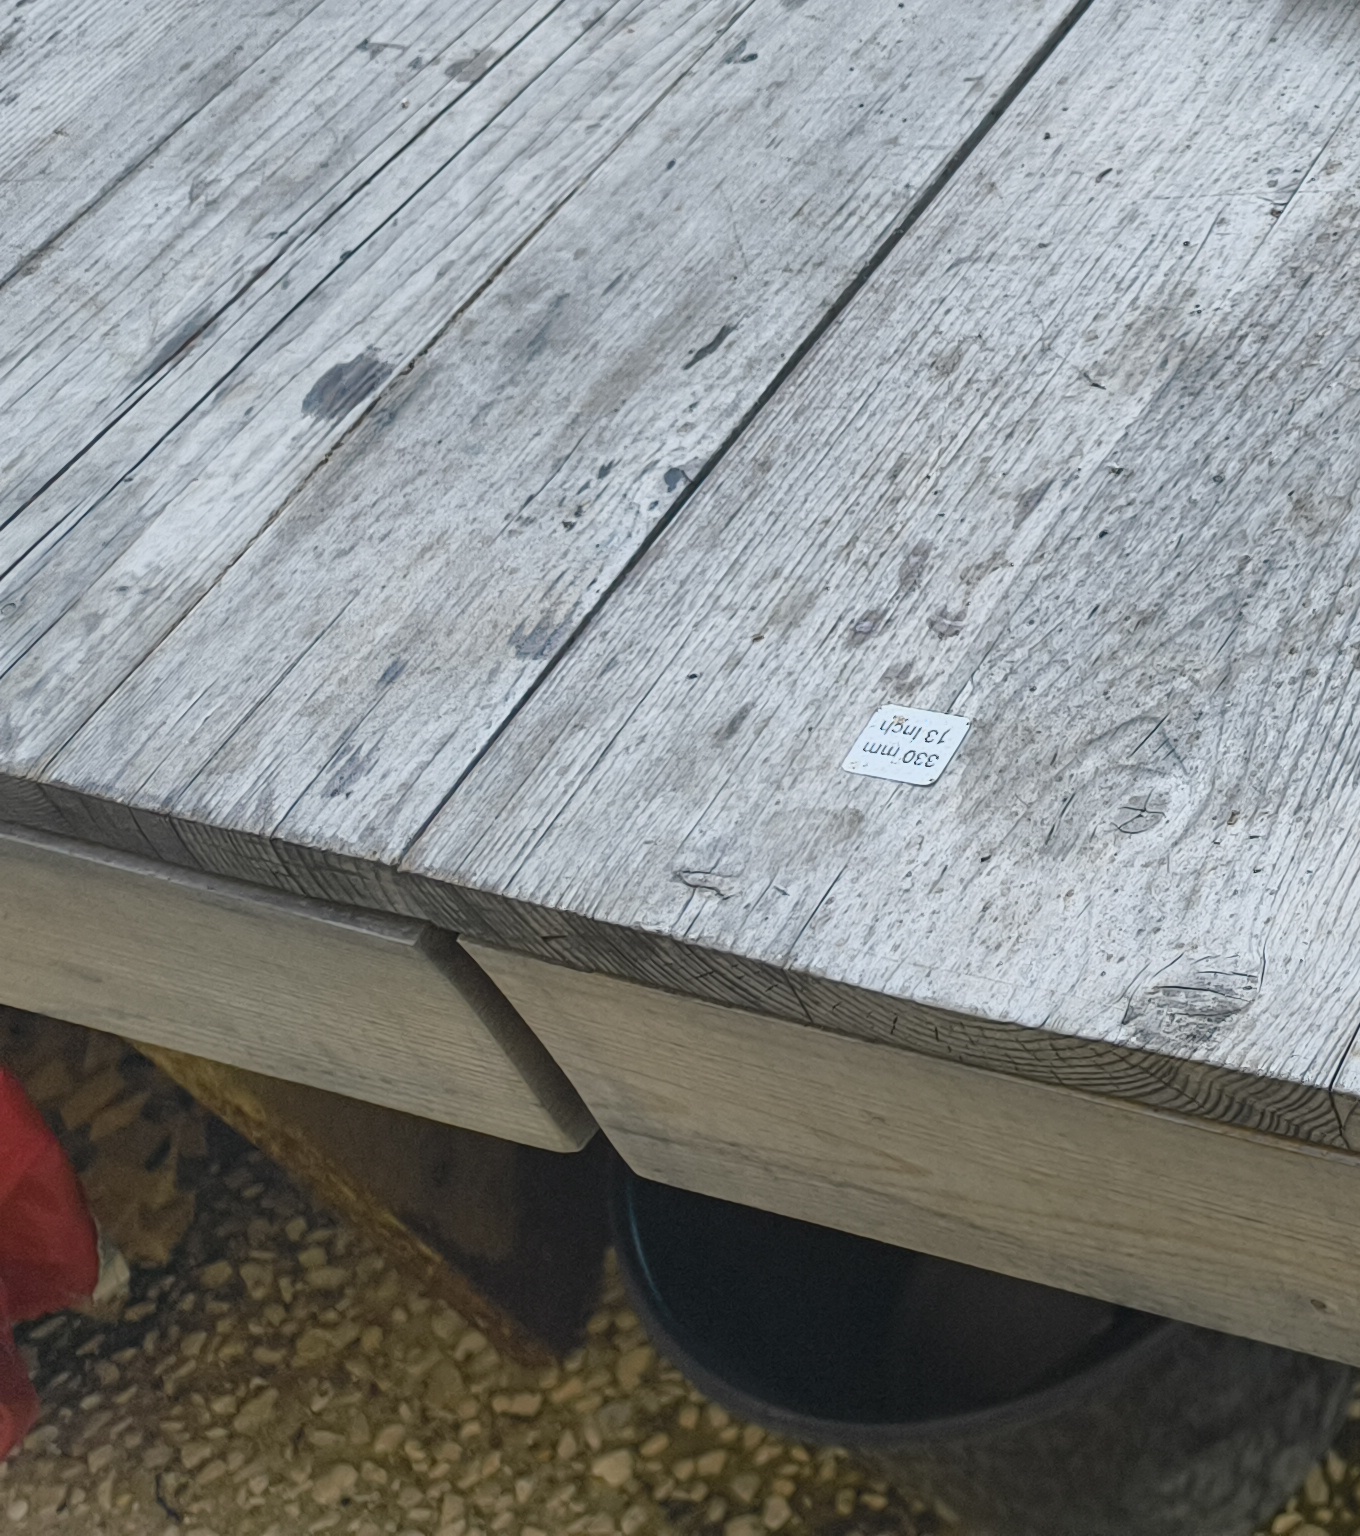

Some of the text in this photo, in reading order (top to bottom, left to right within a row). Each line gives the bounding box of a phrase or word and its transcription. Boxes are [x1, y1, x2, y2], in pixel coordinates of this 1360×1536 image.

[925, 728, 950, 744] 13
[862, 741, 939, 767] 330 mm
